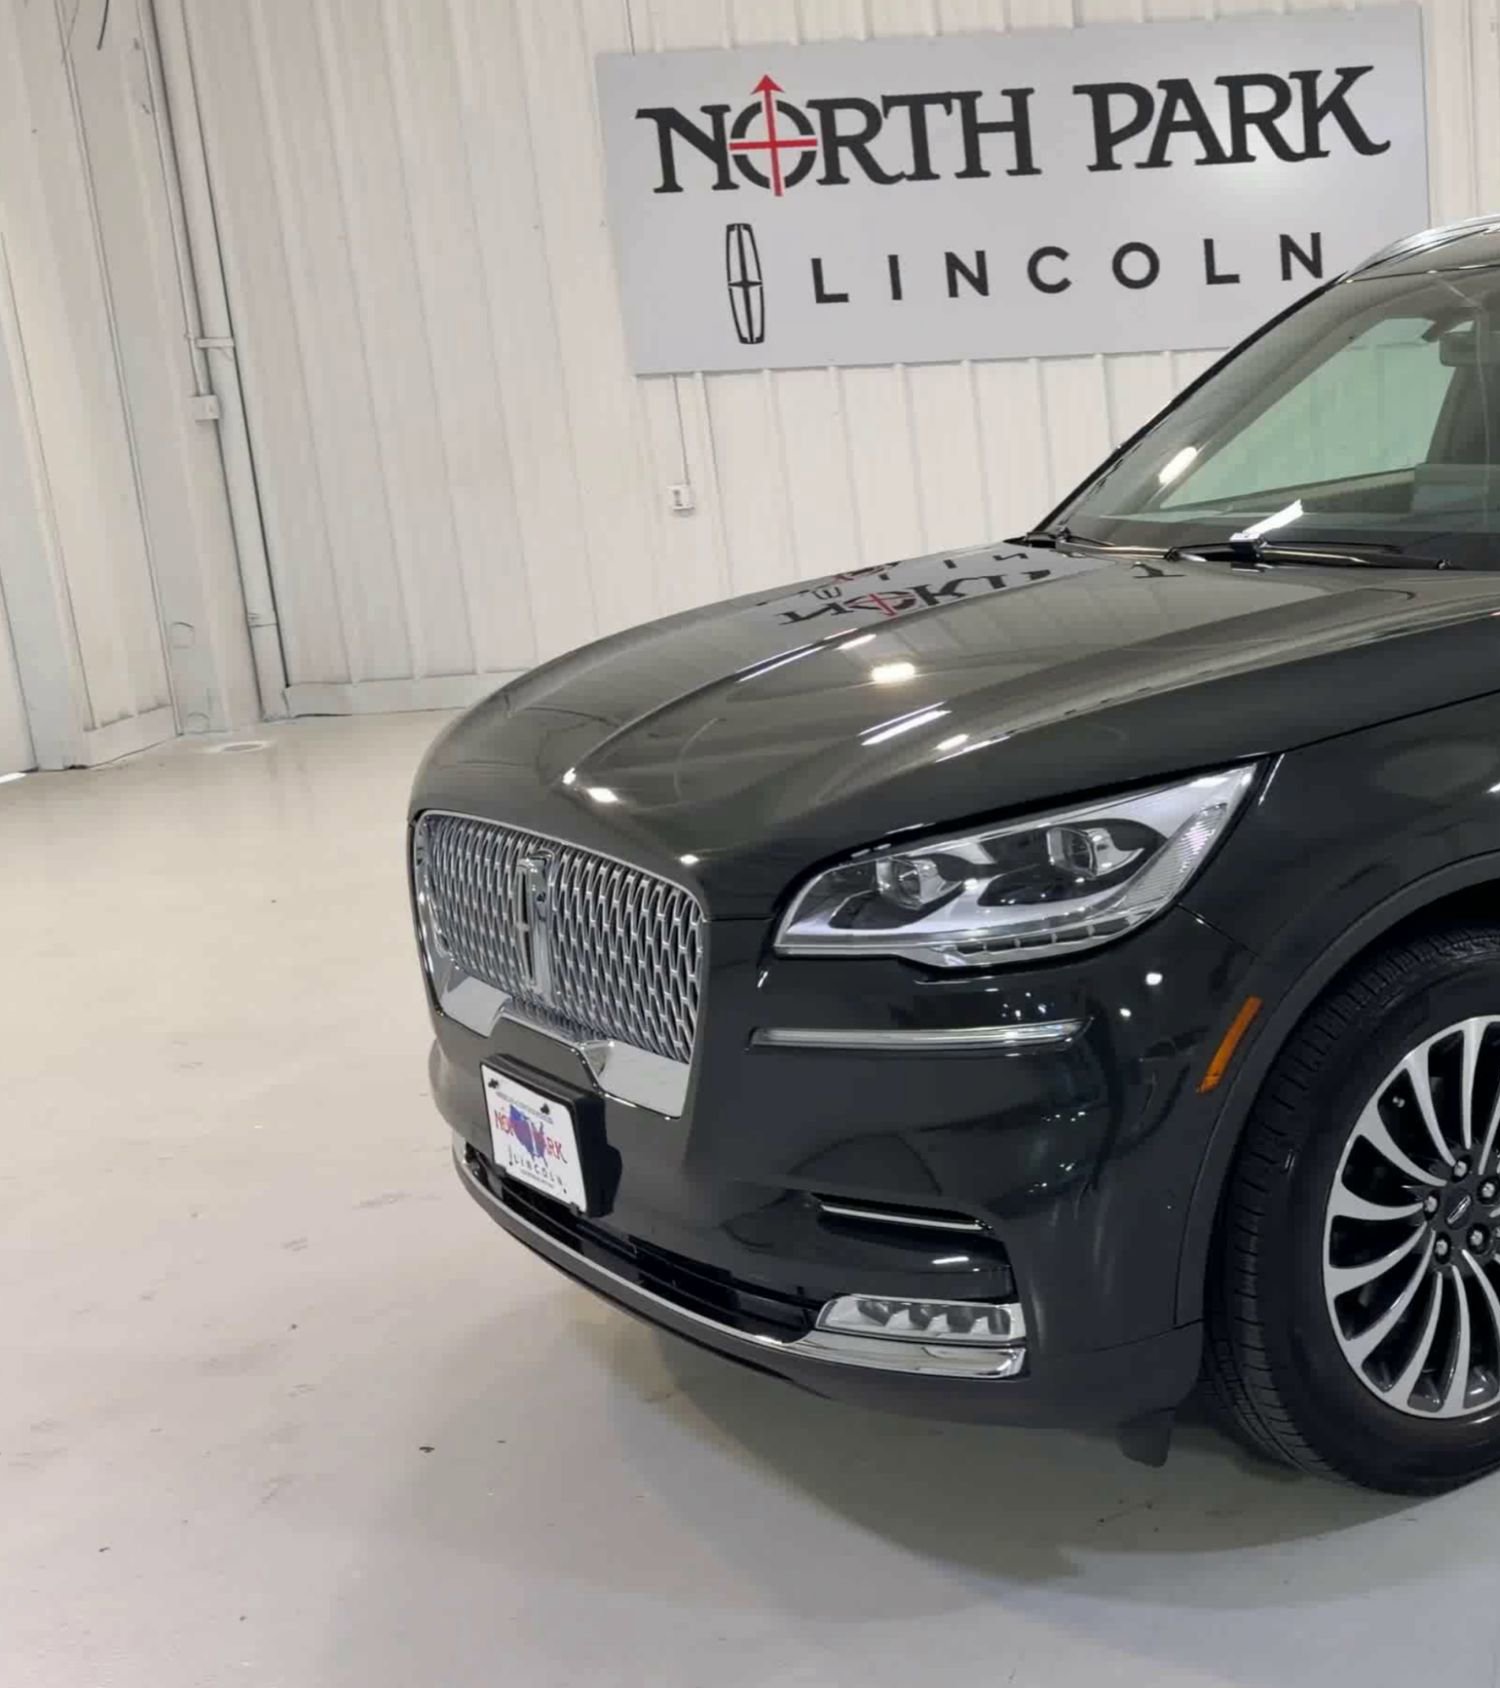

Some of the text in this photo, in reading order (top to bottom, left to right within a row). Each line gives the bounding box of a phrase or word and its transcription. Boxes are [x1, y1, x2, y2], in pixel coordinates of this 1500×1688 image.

[635, 65, 1391, 196] NORTH PARK
[811, 231, 1324, 305] LINCOLN
